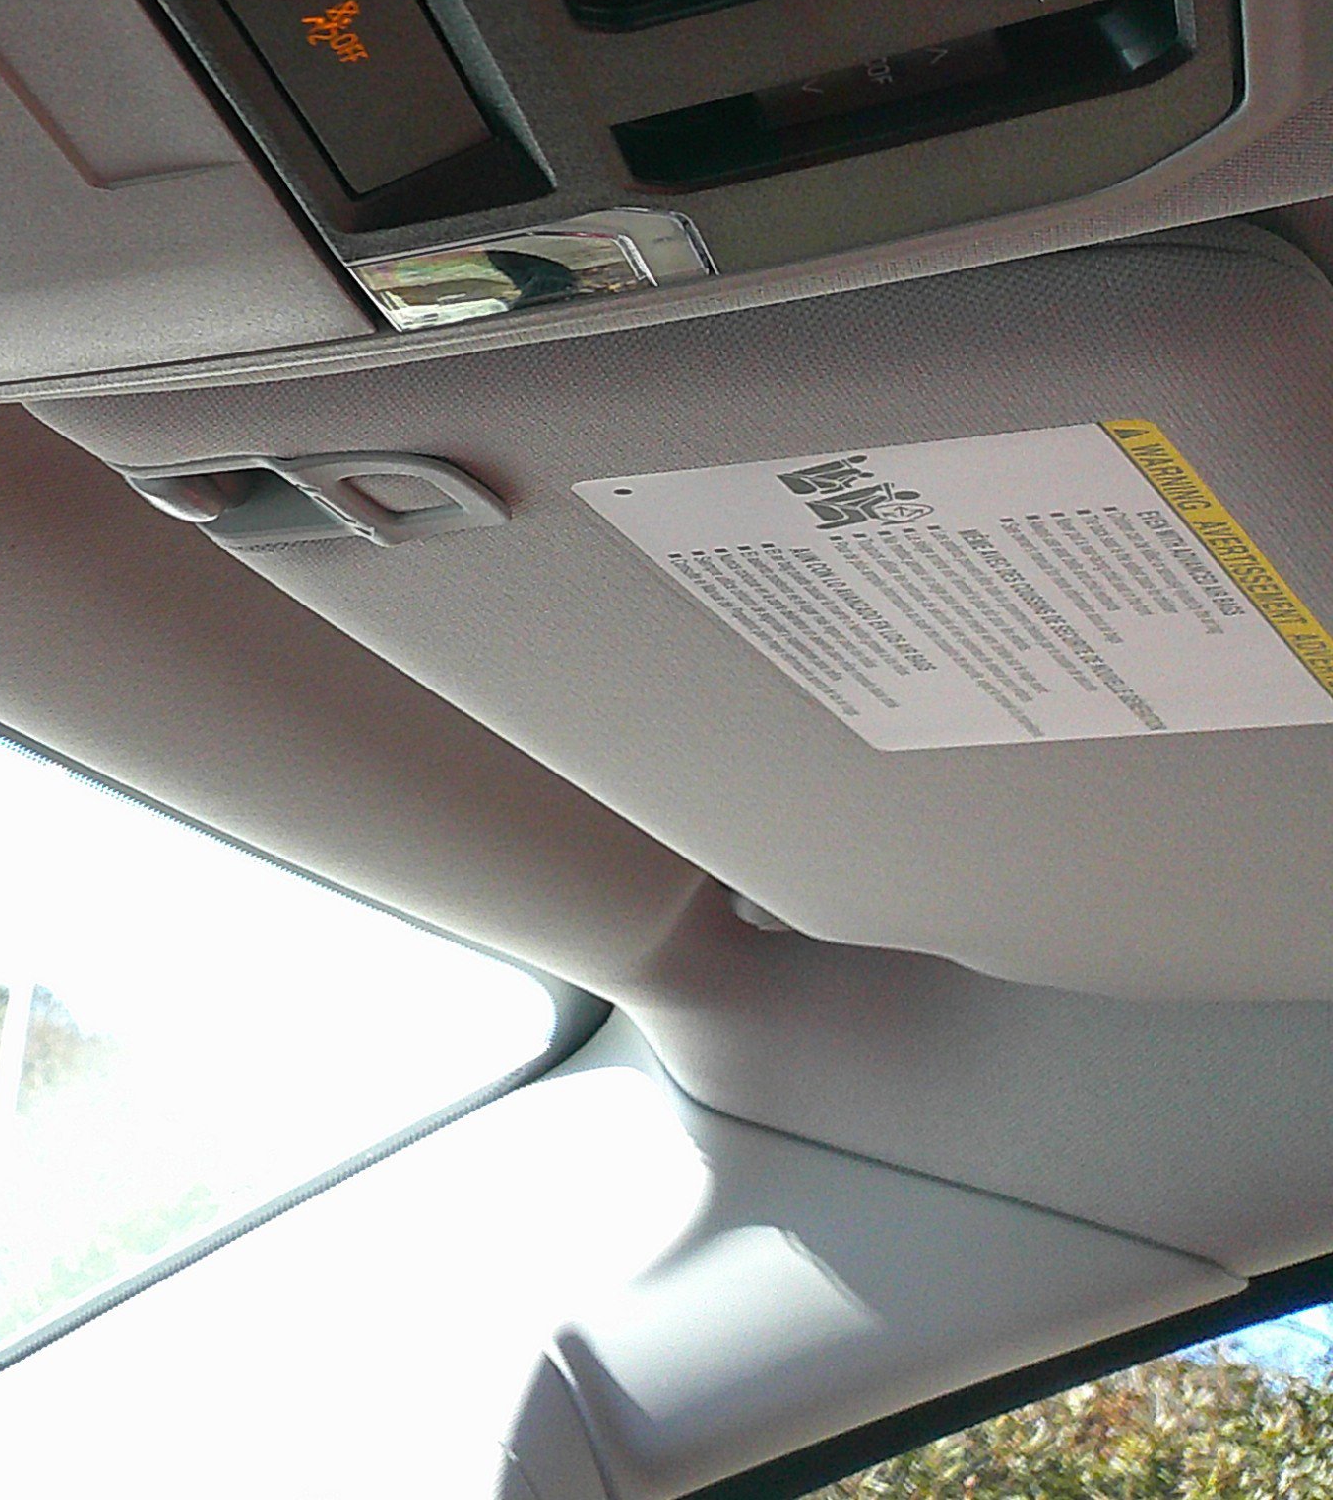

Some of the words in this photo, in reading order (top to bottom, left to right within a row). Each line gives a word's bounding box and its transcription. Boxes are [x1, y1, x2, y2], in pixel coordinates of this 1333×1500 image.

[332, 32, 370, 62] OFF
[1131, 443, 1212, 512] WARNING
[1193, 520, 1308, 626] AVERTISSEMENT
